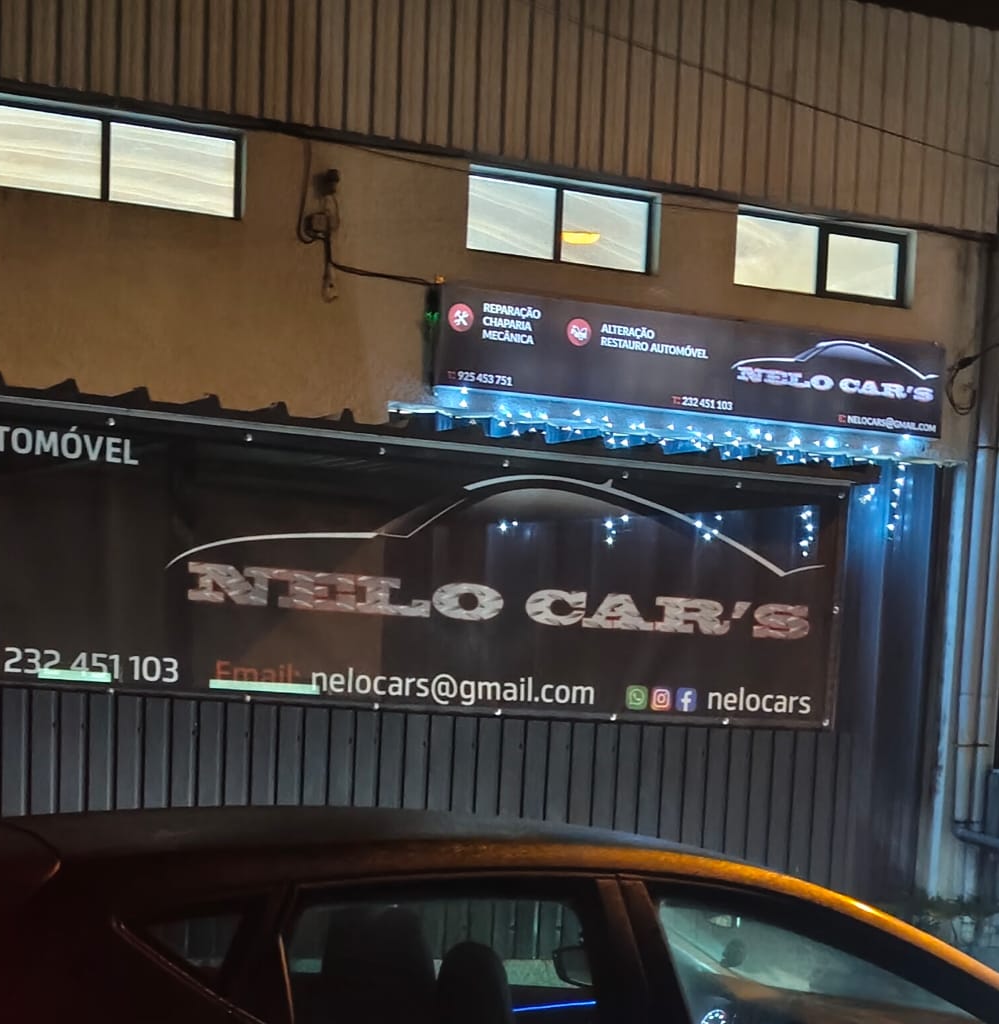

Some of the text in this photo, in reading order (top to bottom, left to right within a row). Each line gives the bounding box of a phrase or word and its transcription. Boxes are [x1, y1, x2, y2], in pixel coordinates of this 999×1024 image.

[483, 303, 541, 319] REPARAÇÃO
[482, 316, 532, 331] CHAPARIA
[600, 323, 655, 340] ALTERAÇÃO
[482, 329, 534, 345] MECÂNICA
[600, 336, 709, 359] RESTAURO AUTOMÓVEL
[458, 371, 476, 382] 925
[476, 373, 494, 384] 453
[495, 375, 512, 386] 751
[736, 366, 934, 402] NELO CAR'S
[681, 396, 699, 407] 232
[699, 398, 716, 409] 451
[716, 399, 733, 411] 103
[847, 414, 936, 433] NELOCARS@GMAIL.COM
[188, 562, 810, 639] NELO CAR'S
[4, 647, 60, 674] 232
[70, 652, 120, 680] 451
[129, 655, 179, 683] 103
[311, 667, 595, 706] nelocars@gmail.com
[707, 686, 811, 714] nelocars
